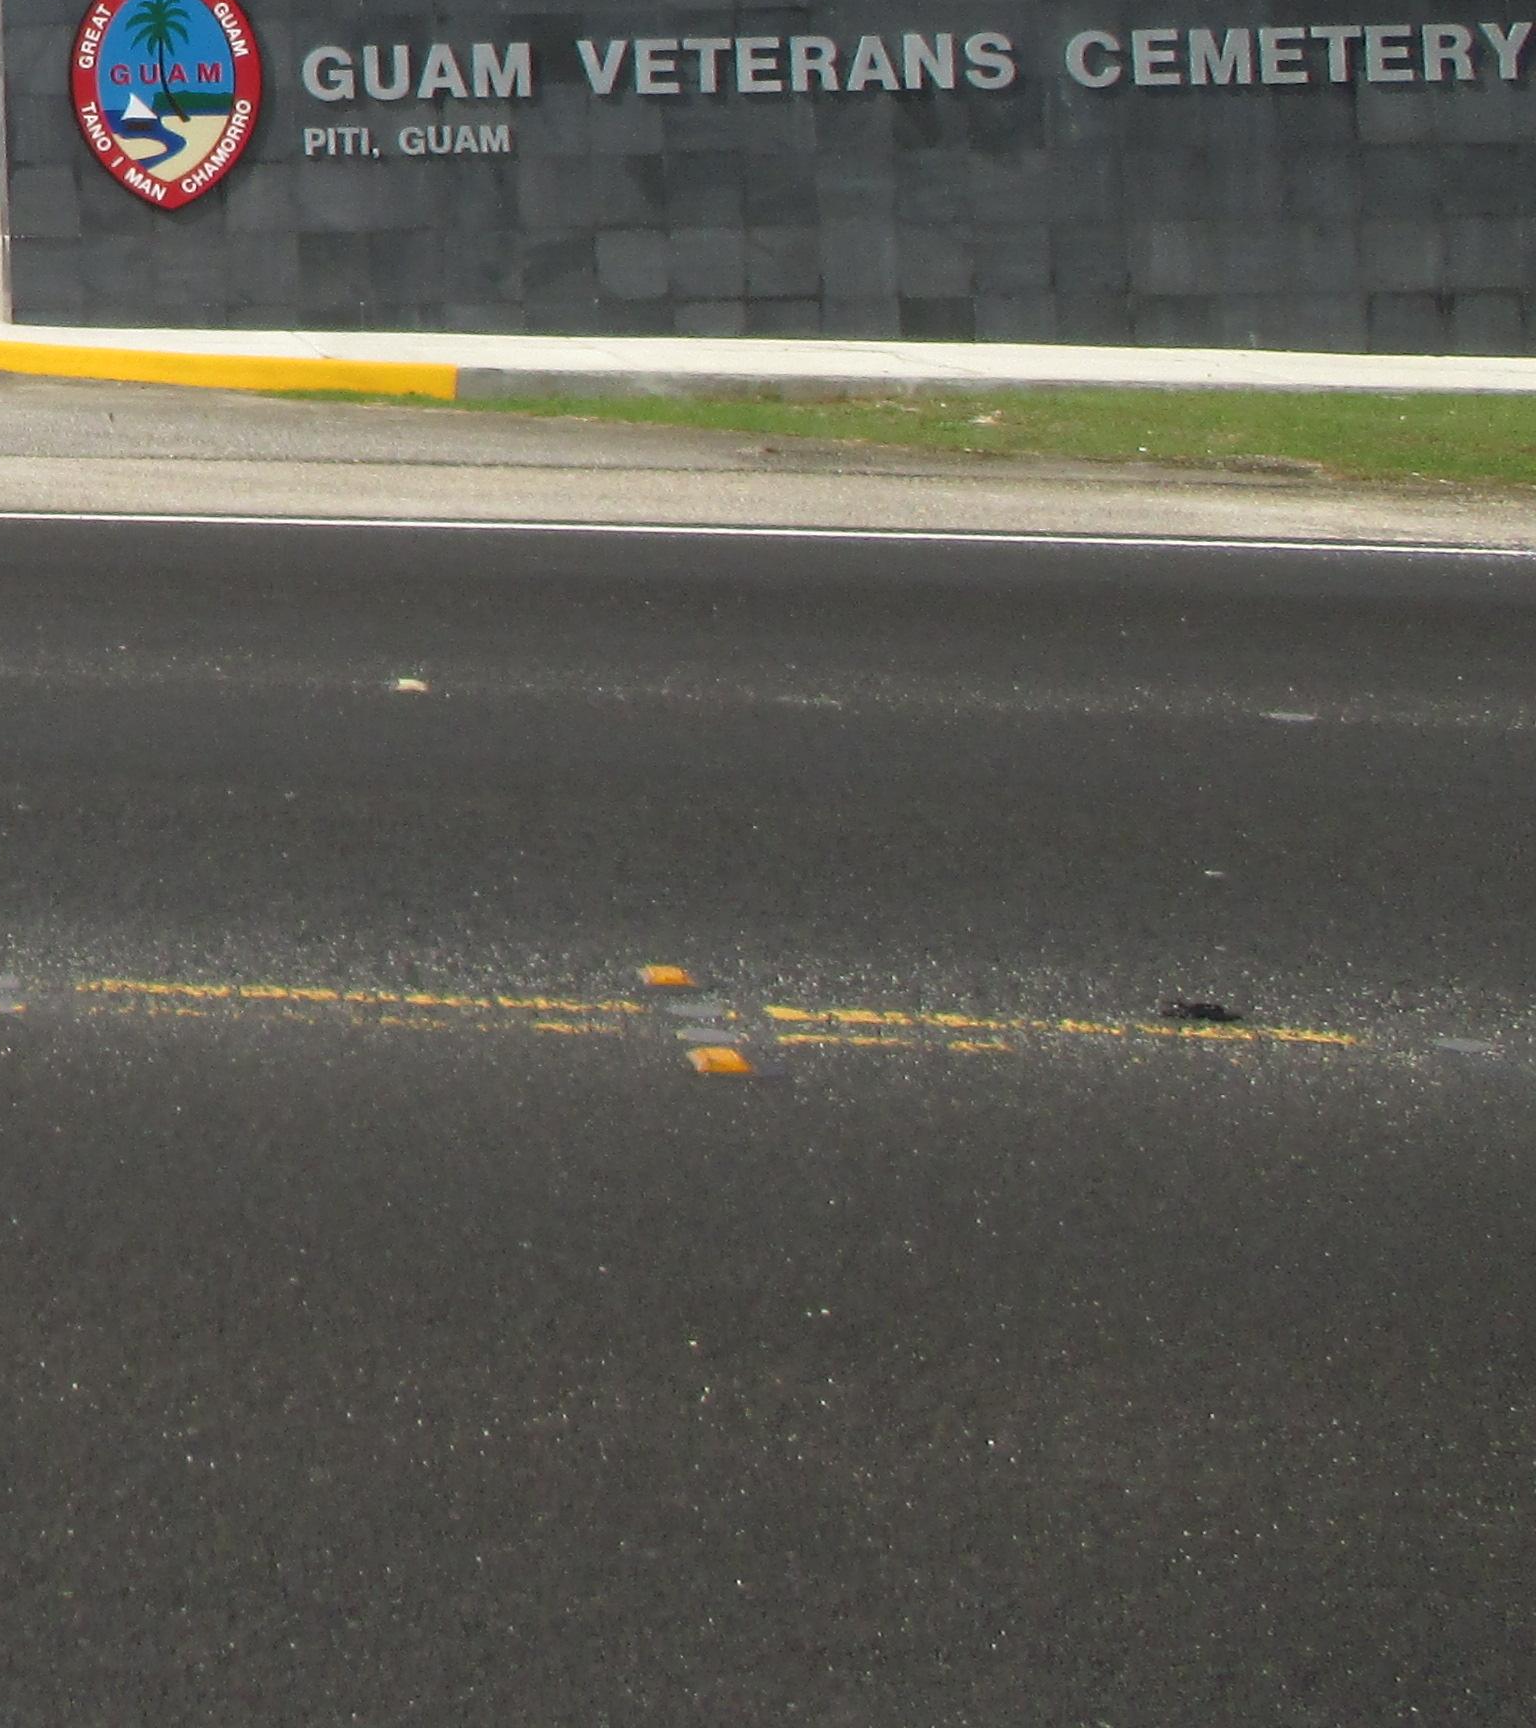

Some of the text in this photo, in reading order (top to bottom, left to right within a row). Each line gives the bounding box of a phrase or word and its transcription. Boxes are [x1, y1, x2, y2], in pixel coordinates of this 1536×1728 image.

[79, 4, 112, 70] GREAT
[213, 2, 249, 57] GUAM
[302, 21, 1533, 103] GUAM VETERANS CEMETERY
[110, 63, 222, 84] GUAM
[82, 99, 252, 201] TANO I MAN CHAMORRO
[303, 125, 512, 158] PITI, GUAM
